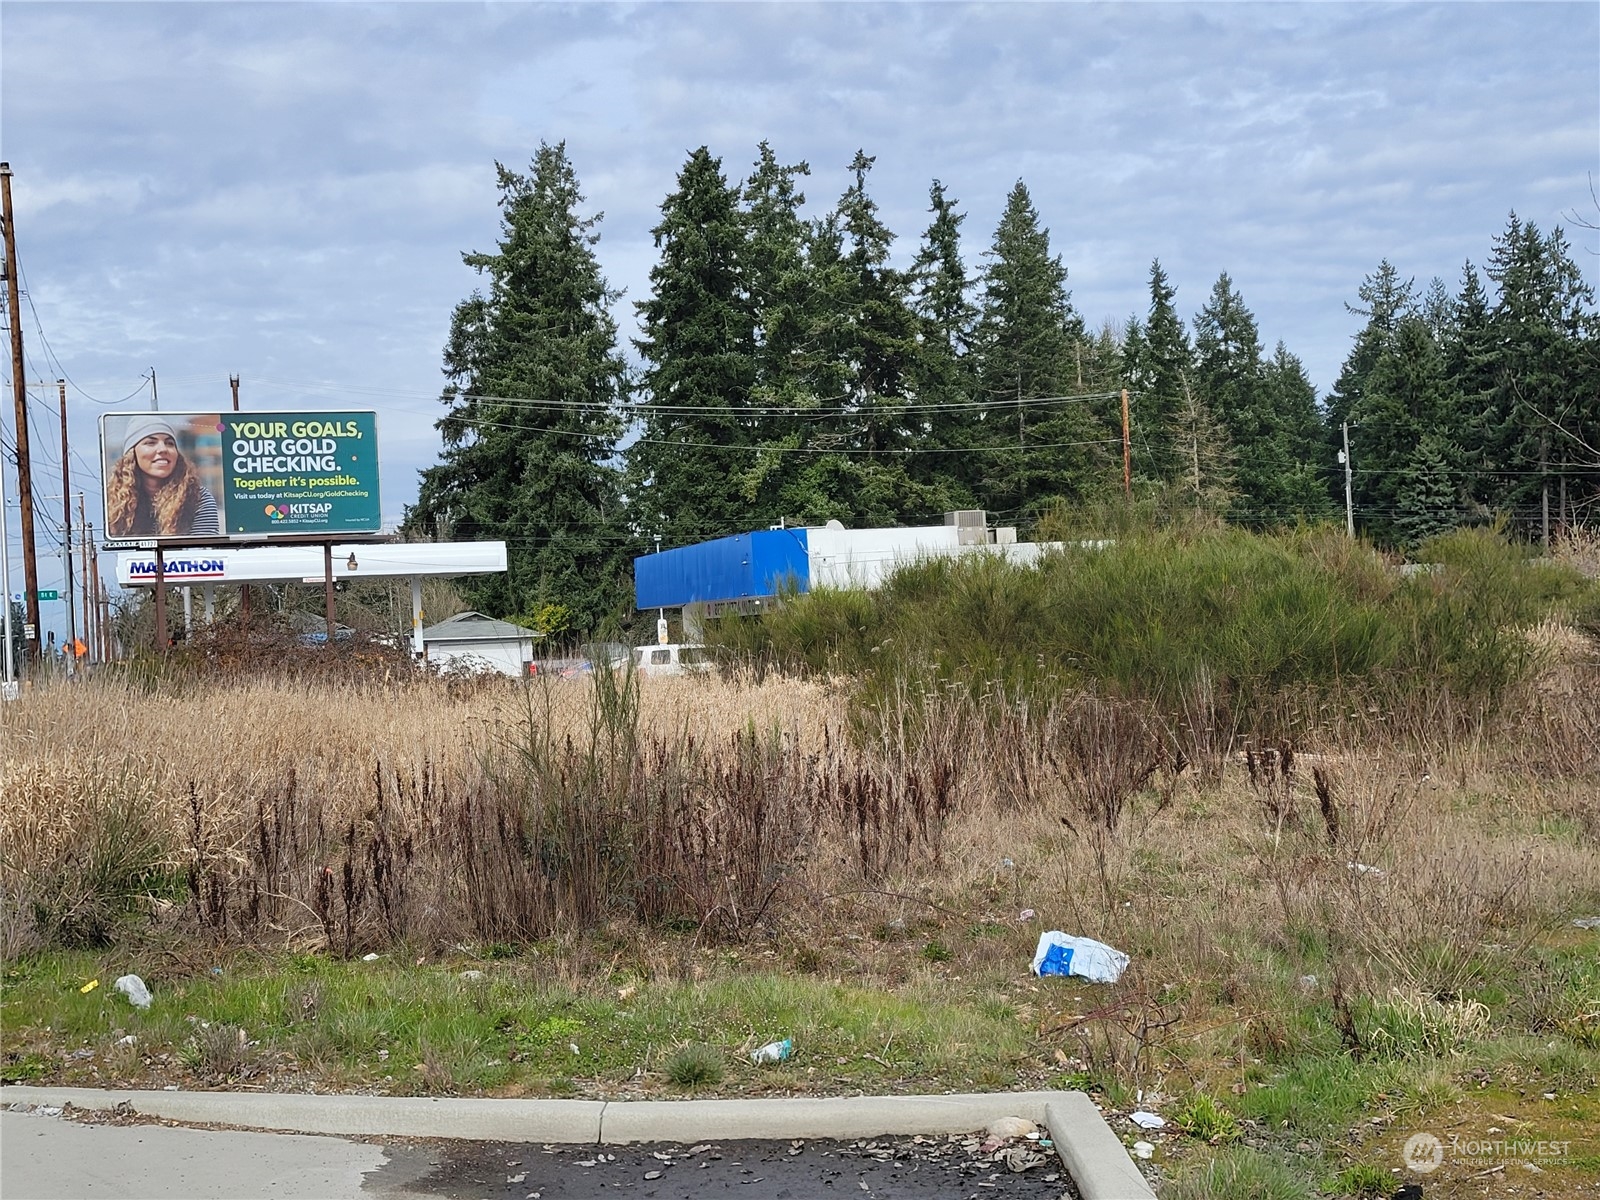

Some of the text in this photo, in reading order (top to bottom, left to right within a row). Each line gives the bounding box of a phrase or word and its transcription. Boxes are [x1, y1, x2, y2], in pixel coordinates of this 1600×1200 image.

[230, 421, 363, 439] YOUR GOALS,
[232, 438, 337, 456] OUR GOLD
[233, 456, 342, 473] CHECKING.
[233, 475, 360, 490] Together it's possible.
[257, 492, 275, 500] today
[283, 490, 369, 500] KitsapCU.org/GoldChecking
[290, 503, 333, 514] KITSAP
